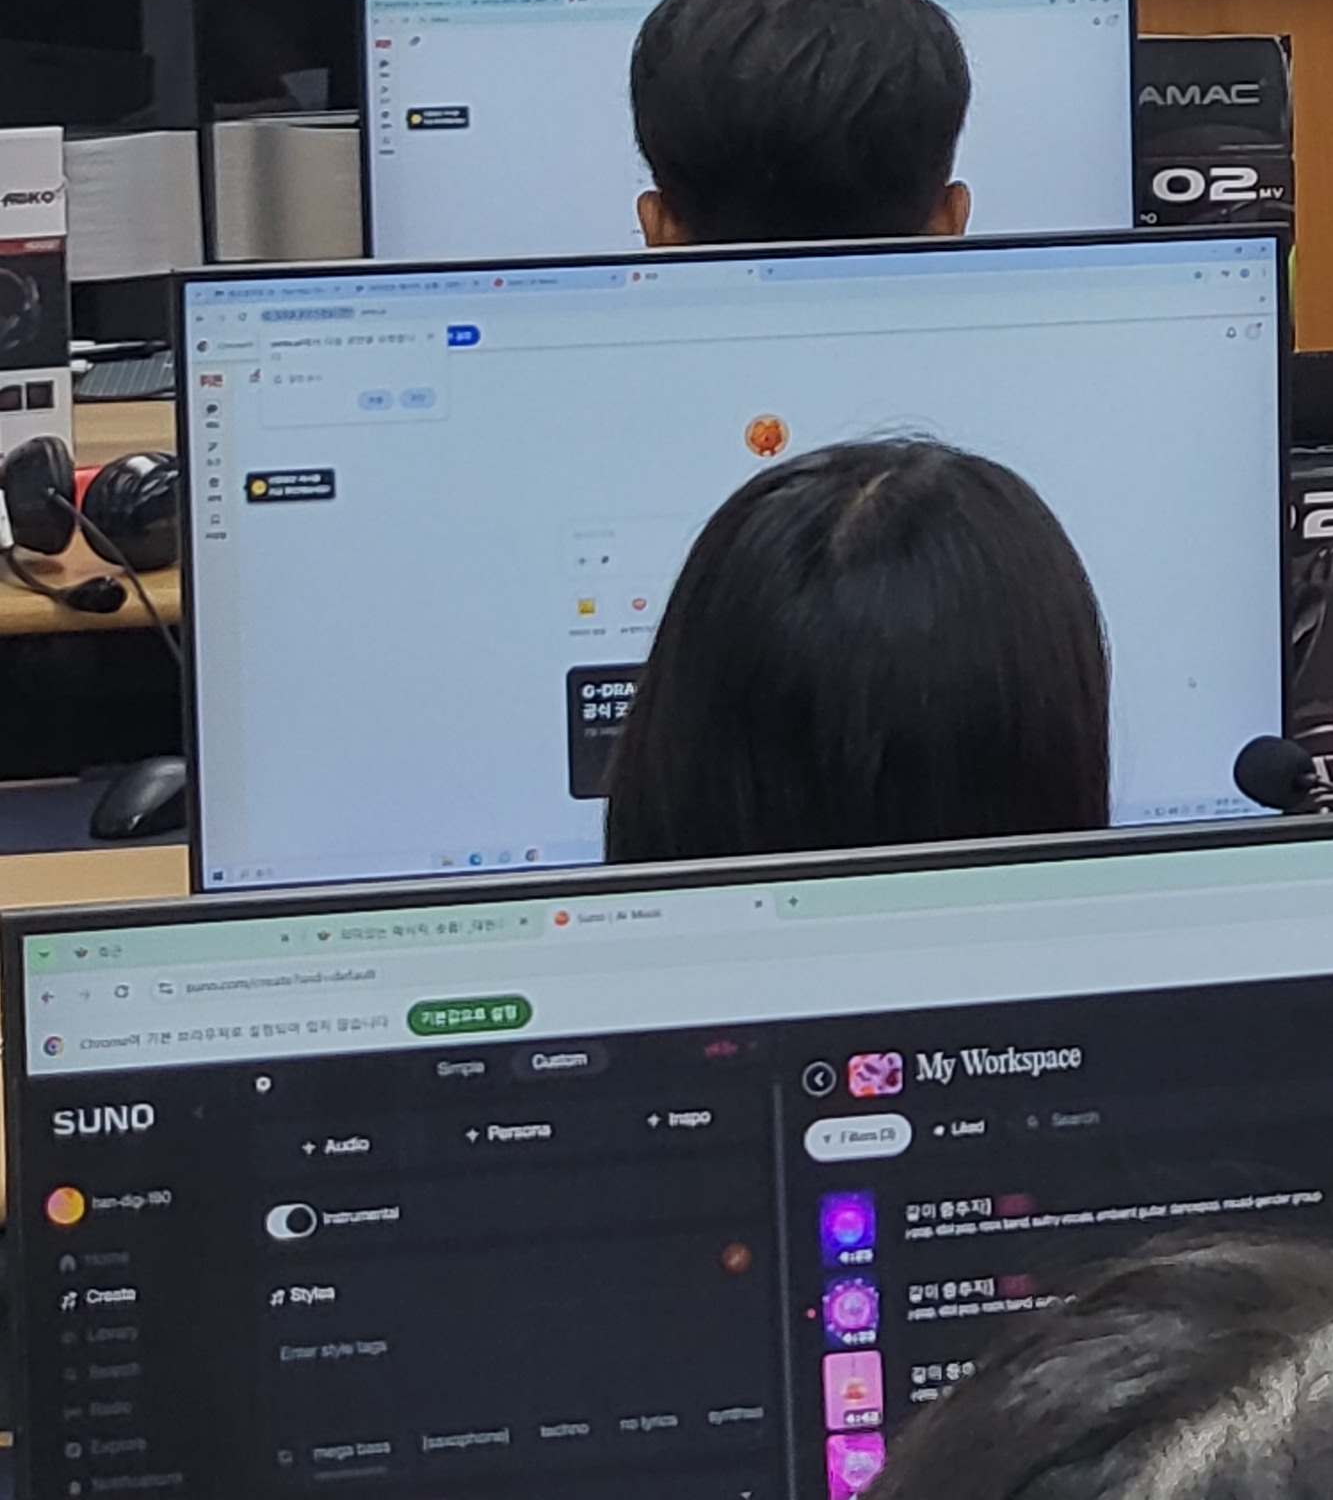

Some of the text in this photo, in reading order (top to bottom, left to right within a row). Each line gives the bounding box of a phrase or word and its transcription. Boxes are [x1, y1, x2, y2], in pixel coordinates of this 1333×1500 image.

[1259, 187, 1284, 199] MV
[532, 1051, 589, 1071] Custom
[915, 1046, 1082, 1084] My Workspace
[52, 1102, 155, 1136] SUNO
[487, 1123, 552, 1142] Persona
[323, 1136, 371, 1155] Audio
[85, 1288, 137, 1303] Create
[290, 1286, 336, 1305] Styles
